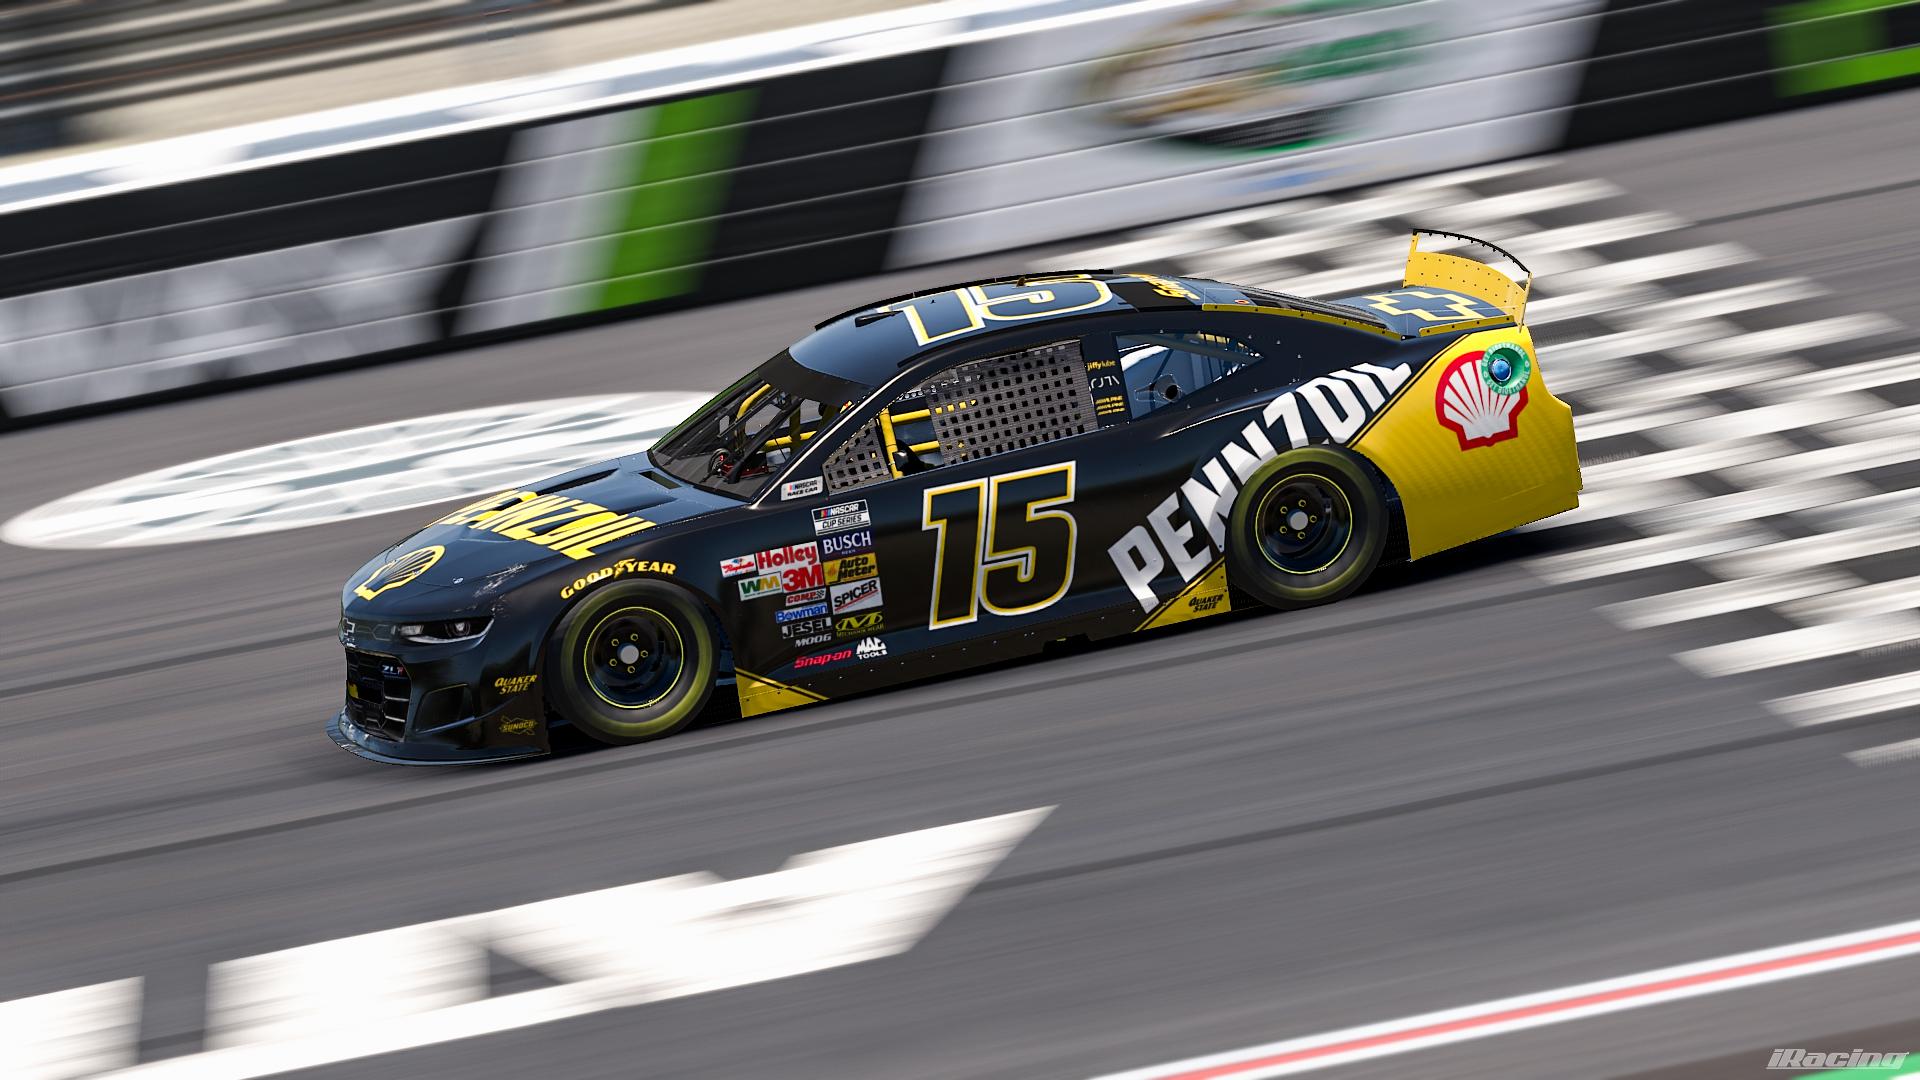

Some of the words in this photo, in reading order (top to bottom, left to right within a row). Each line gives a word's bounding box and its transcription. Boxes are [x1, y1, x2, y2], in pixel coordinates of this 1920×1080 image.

[876, 273, 1112, 346] 15
[787, 489, 803, 497] RACE
[804, 486, 818, 494] CAR
[794, 480, 818, 490] NASCAR
[1107, 362, 1412, 614] PENNZOIL
[830, 503, 859, 516] NASCAR
[822, 519, 837, 528] CUP
[838, 514, 862, 526] SERIES
[822, 531, 872, 554] BUSCH
[922, 460, 1078, 630] 15
[756, 546, 816, 570] Holley
[840, 556, 868, 569] Auto
[560, 559, 677, 600] GOODYEAR
[782, 563, 824, 593] 3M
[838, 565, 875, 582] Meter
[741, 575, 780, 594] WM
[787, 591, 816, 604] COMP
[834, 579, 877, 608] SPICER
[776, 605, 828, 622] Bowman
[782, 618, 832, 638] JESEL
[795, 633, 832, 648] MOOG
[857, 637, 887, 654] MAC
[794, 649, 852, 669] Snap-on
[857, 650, 888, 660] TOOLS
[494, 674, 538, 688] QUAKER
[499, 683, 531, 695] STATE
[502, 720, 535, 732] SUNOCO
